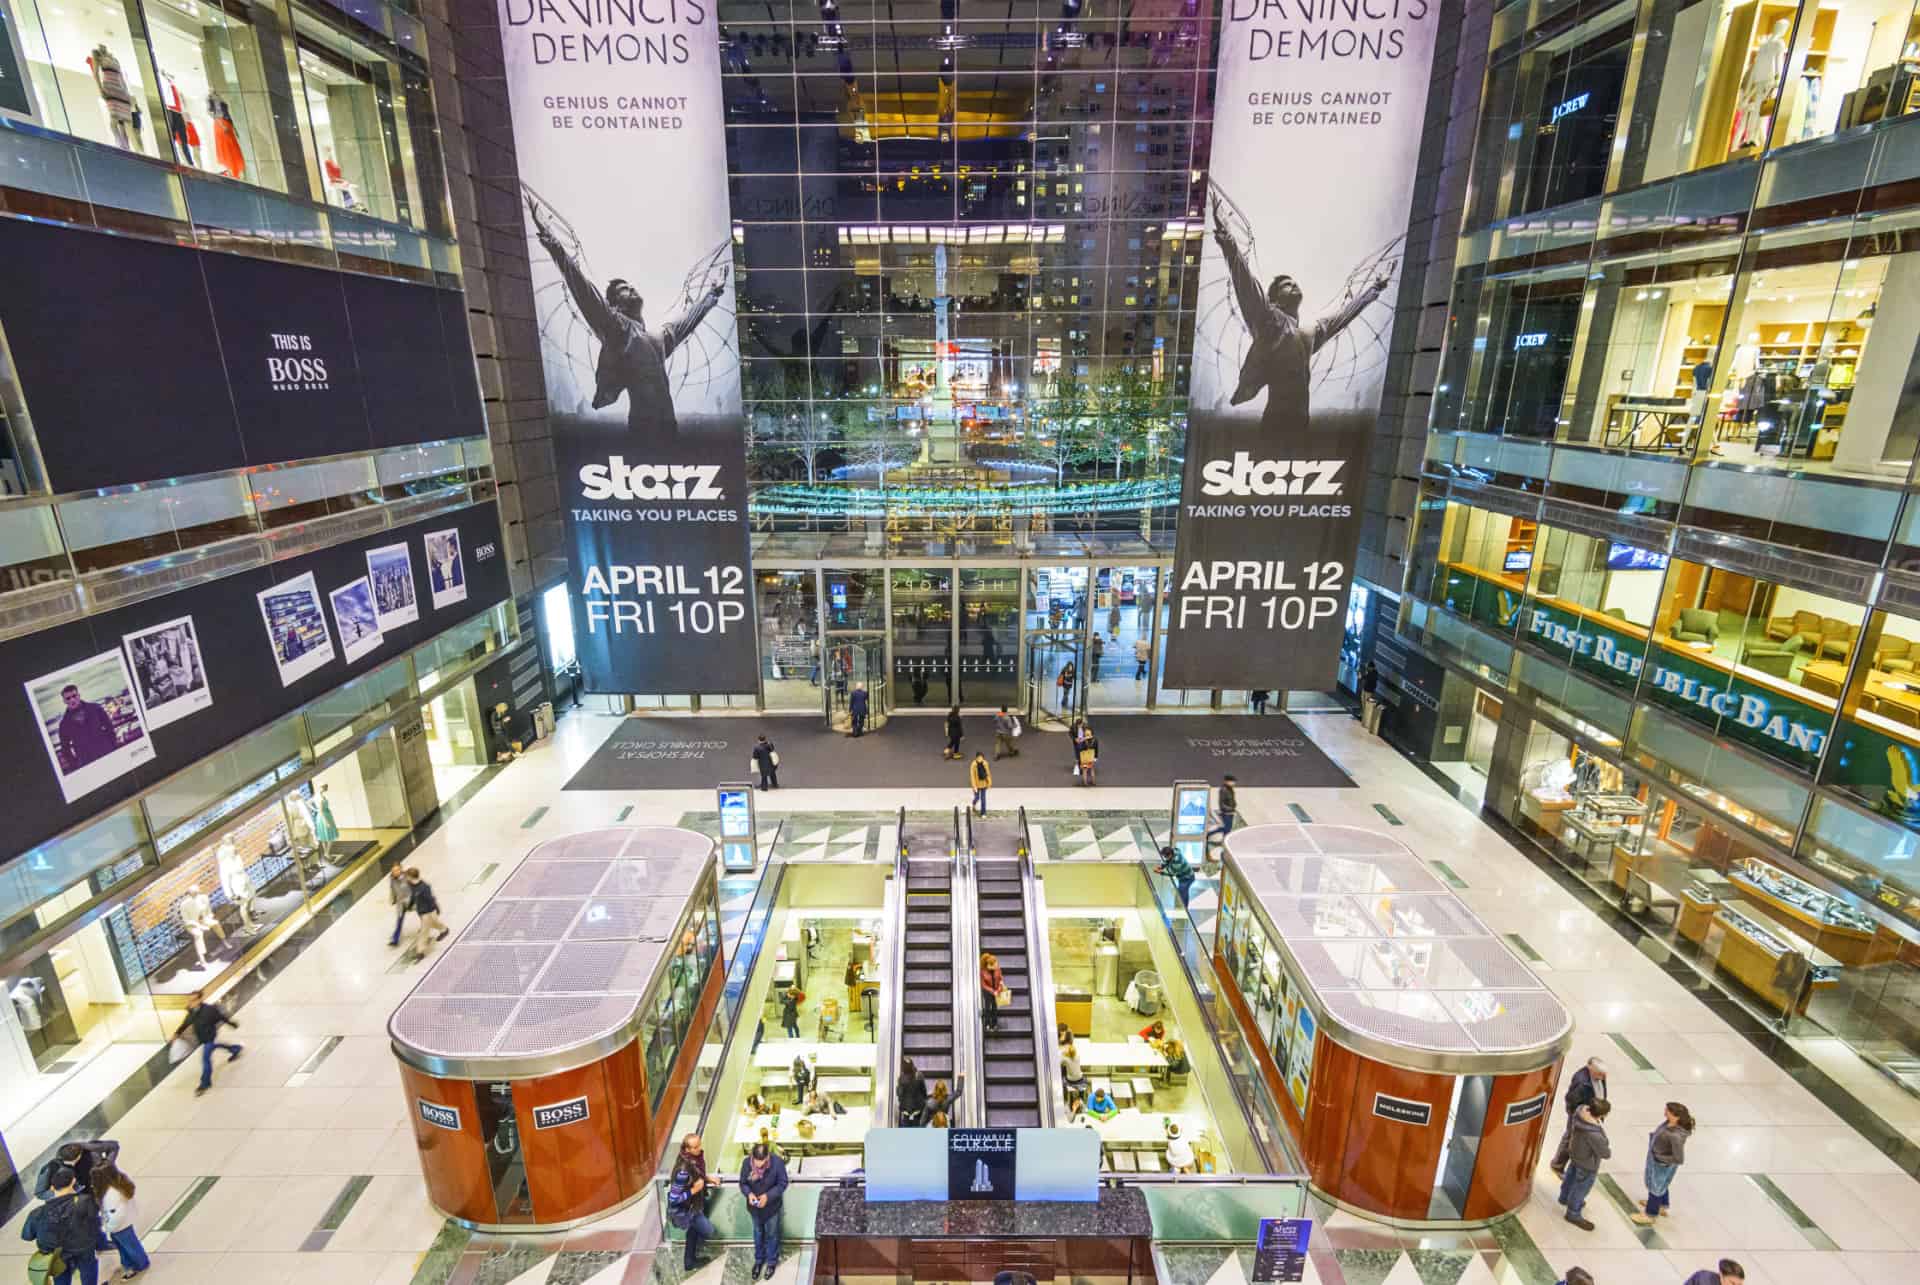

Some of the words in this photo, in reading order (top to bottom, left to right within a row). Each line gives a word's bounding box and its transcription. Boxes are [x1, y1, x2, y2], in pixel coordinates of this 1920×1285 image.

[532, 33, 689, 65] DEMONS
[1249, 29, 1405, 61] DEMONS
[543, 96, 609, 109] GENIUS
[617, 96, 688, 110] CANNOT
[1248, 92, 1313, 105] GENIUS
[1321, 92, 1392, 105] CANNOT
[551, 115, 574, 129] BE
[581, 116, 683, 129] CONTAINED
[1252, 112, 1275, 125] BE
[1281, 112, 1382, 125] CONTAINED
[271, 334, 299, 351] THIS
[299, 335, 312, 351] IS
[266, 358, 328, 382] BOSS
[579, 455, 721, 500] starz
[1201, 452, 1346, 496] starz
[572, 509, 632, 521] TAKING
[636, 509, 672, 521] YOU
[676, 509, 738, 522] PLACES
[1187, 505, 1246, 517] TAKING
[1250, 505, 1285, 517] YOU
[1288, 505, 1352, 517] PLACES
[582, 565, 700, 595] APRIL
[703, 565, 744, 595] 12
[1180, 561, 1296, 590] APRIL
[1303, 561, 1344, 590] 12
[586, 600, 655, 634] FRI
[669, 600, 744, 634] 10P
[1179, 596, 1246, 629] FRI
[1261, 596, 1338, 630] 10P
[1530, 610, 1592, 654] FIRST
[423, 1104, 454, 1122] BOSS
[541, 1103, 583, 1121] BOSS
